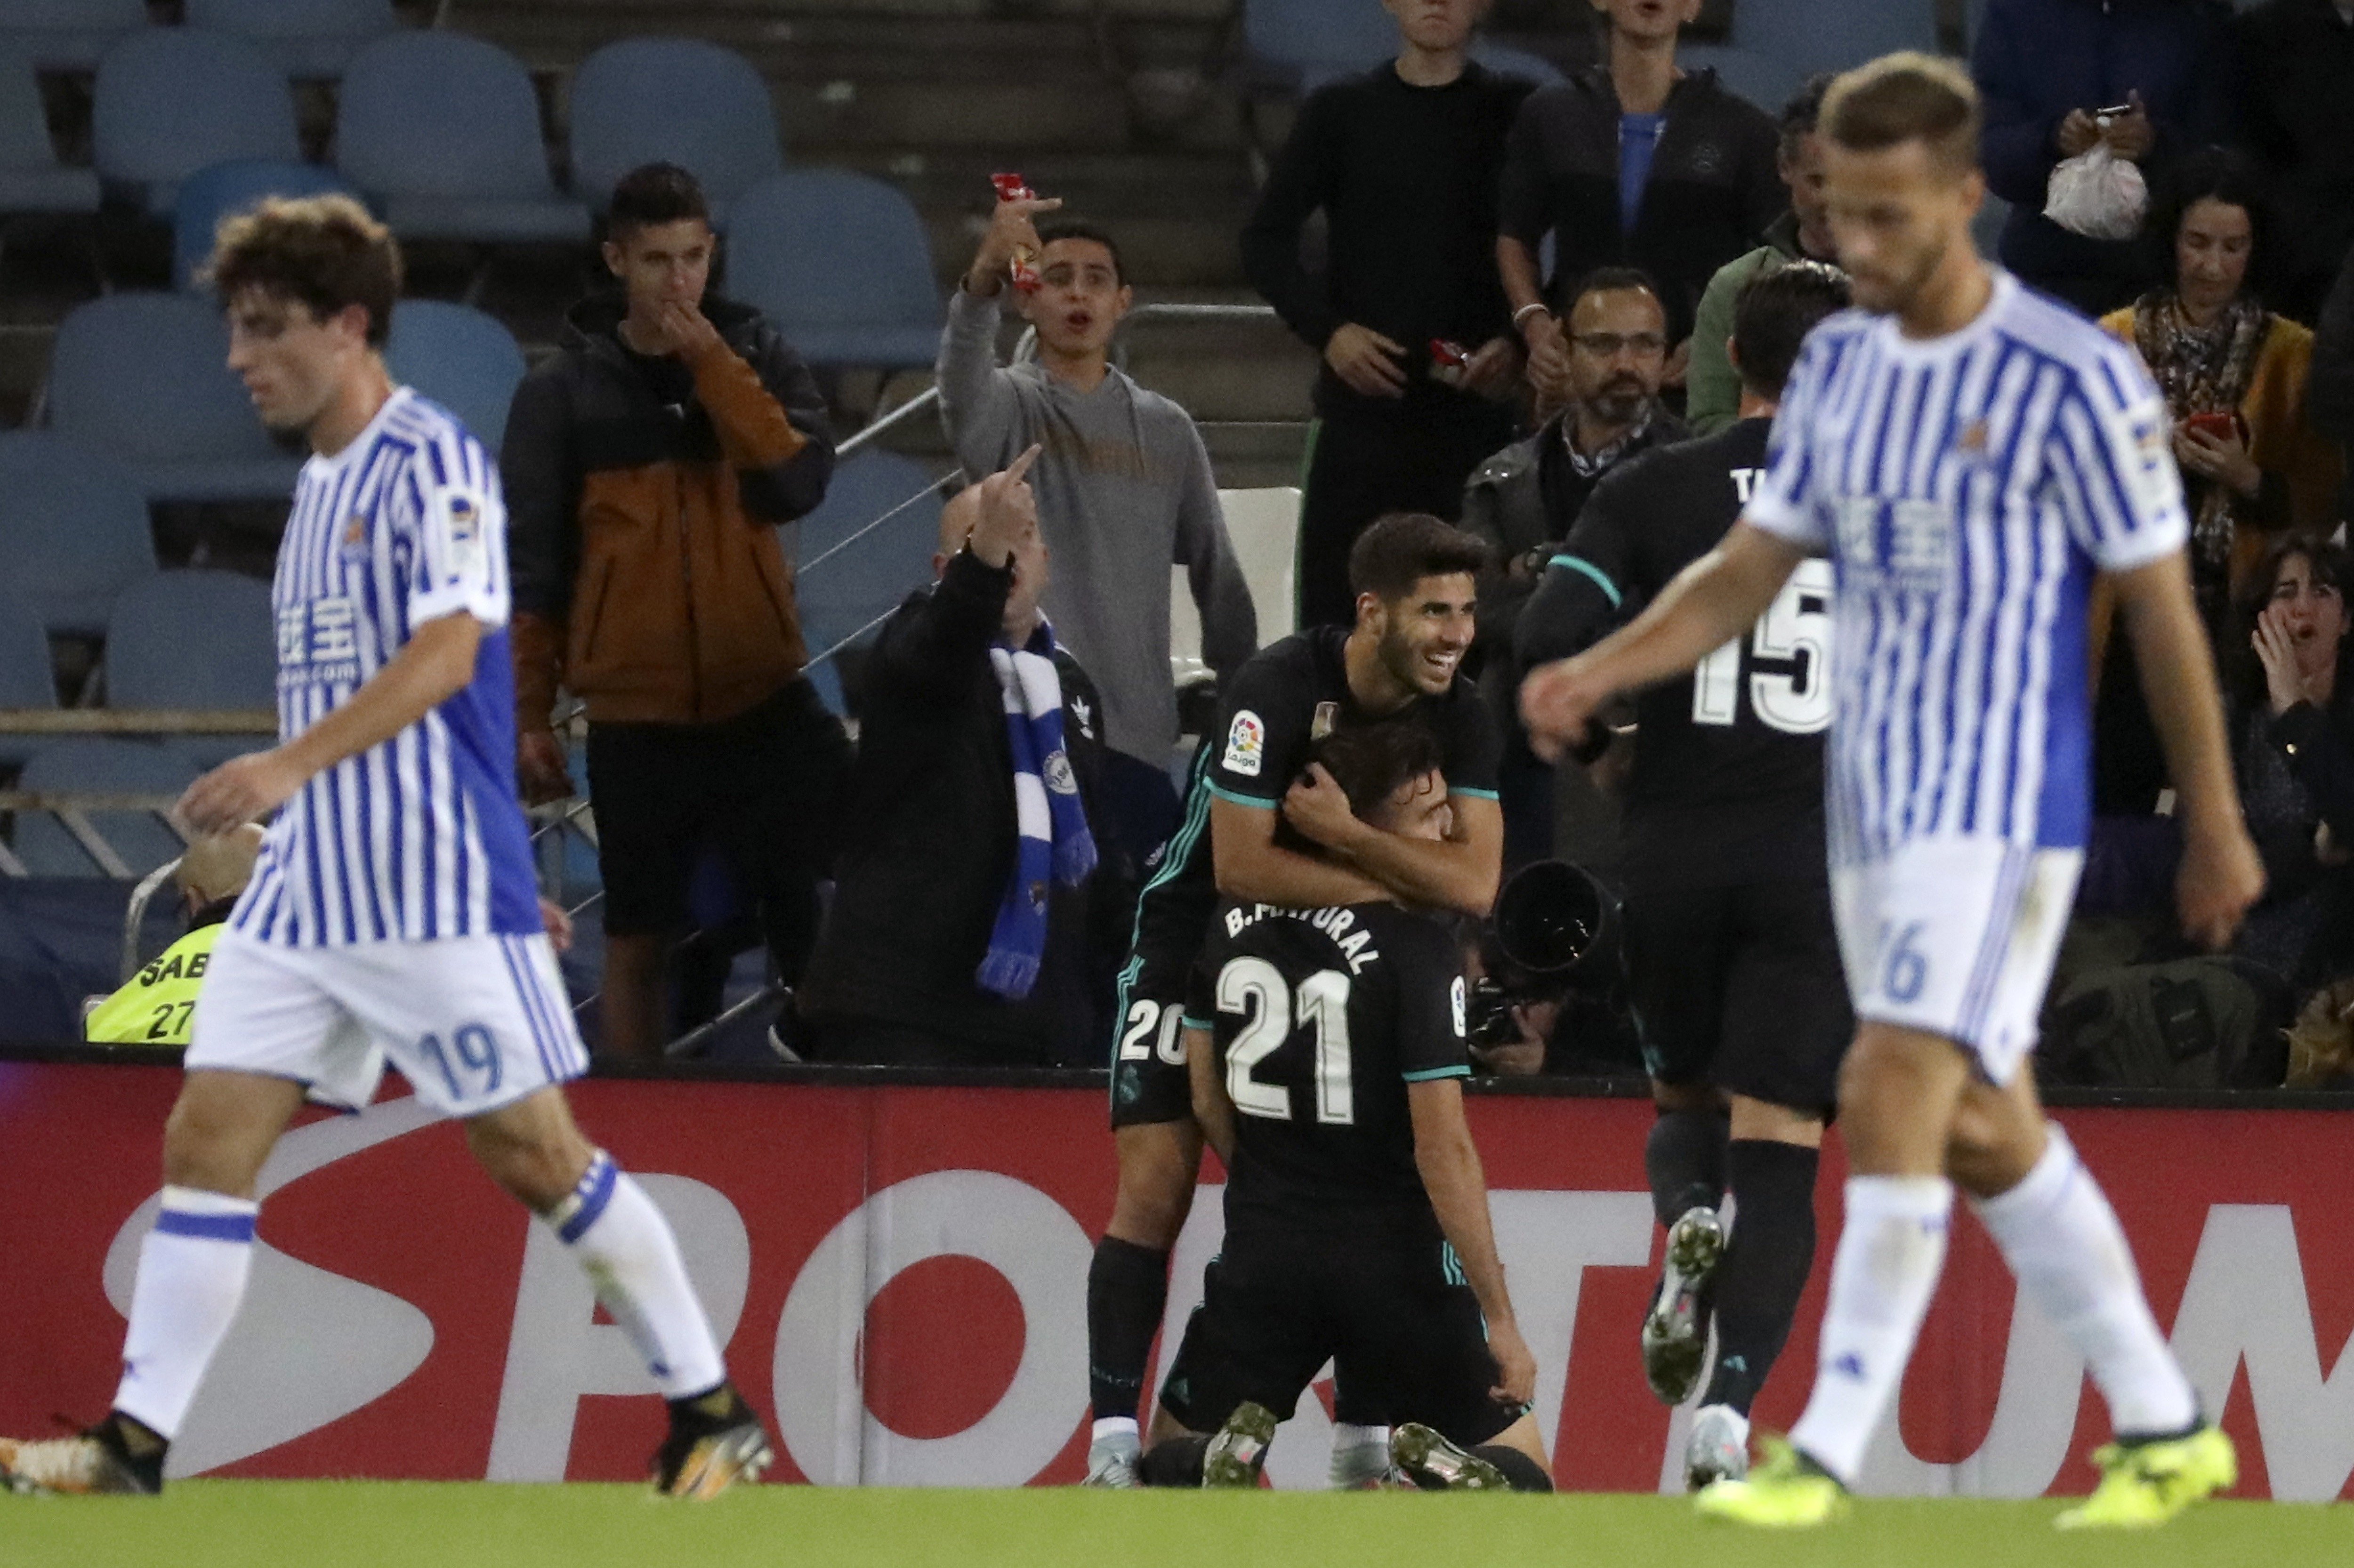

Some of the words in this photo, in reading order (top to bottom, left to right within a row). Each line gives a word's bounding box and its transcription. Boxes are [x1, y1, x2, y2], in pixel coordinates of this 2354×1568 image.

[147, 1001, 197, 1039] 27
[1120, 999, 1187, 1065] 20
[1216, 956, 1354, 1125] 21
[420, 1023, 502, 1102] 19
